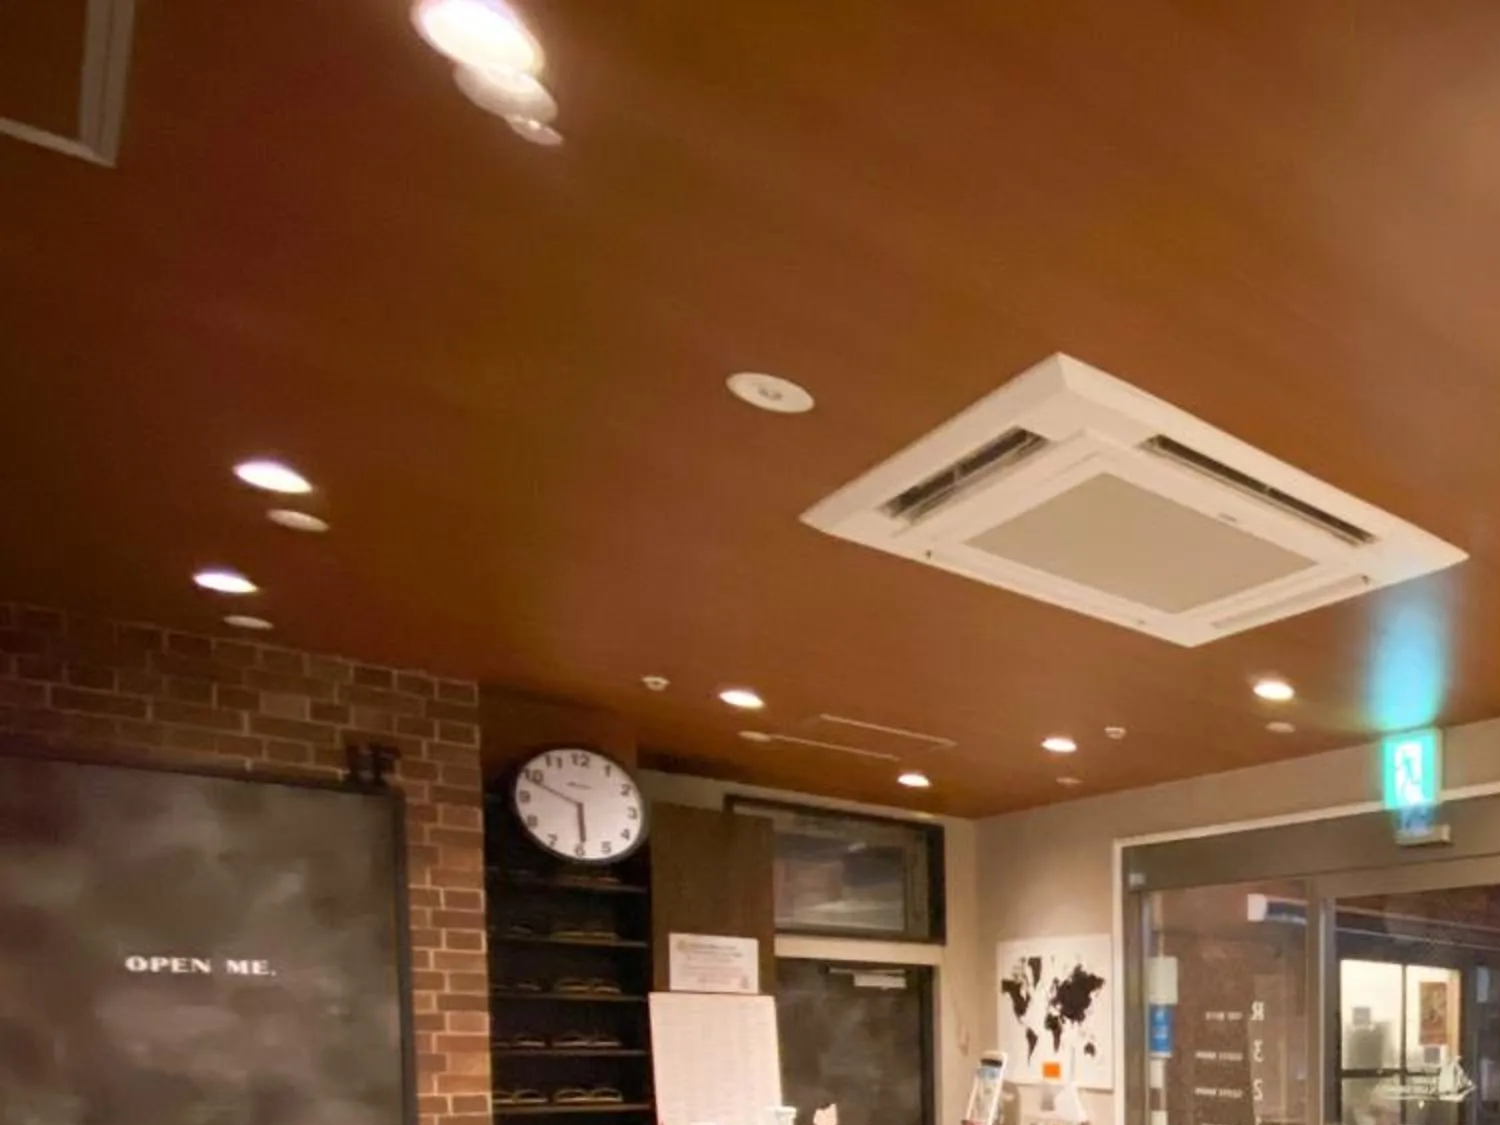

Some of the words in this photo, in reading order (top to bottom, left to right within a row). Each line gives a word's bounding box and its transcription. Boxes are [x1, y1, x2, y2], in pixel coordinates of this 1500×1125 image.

[545, 753, 563, 769] 11
[571, 753, 590, 768] 12
[524, 768, 544, 784] 10
[604, 764, 612, 778] 1
[620, 783, 631, 797] 2
[627, 806, 638, 819] 3
[547, 833, 558, 847] 7
[620, 829, 630, 841] 4
[601, 841, 612, 854] 5
[124, 955, 212, 974] OPEN
[225, 958, 277, 976] ME.
